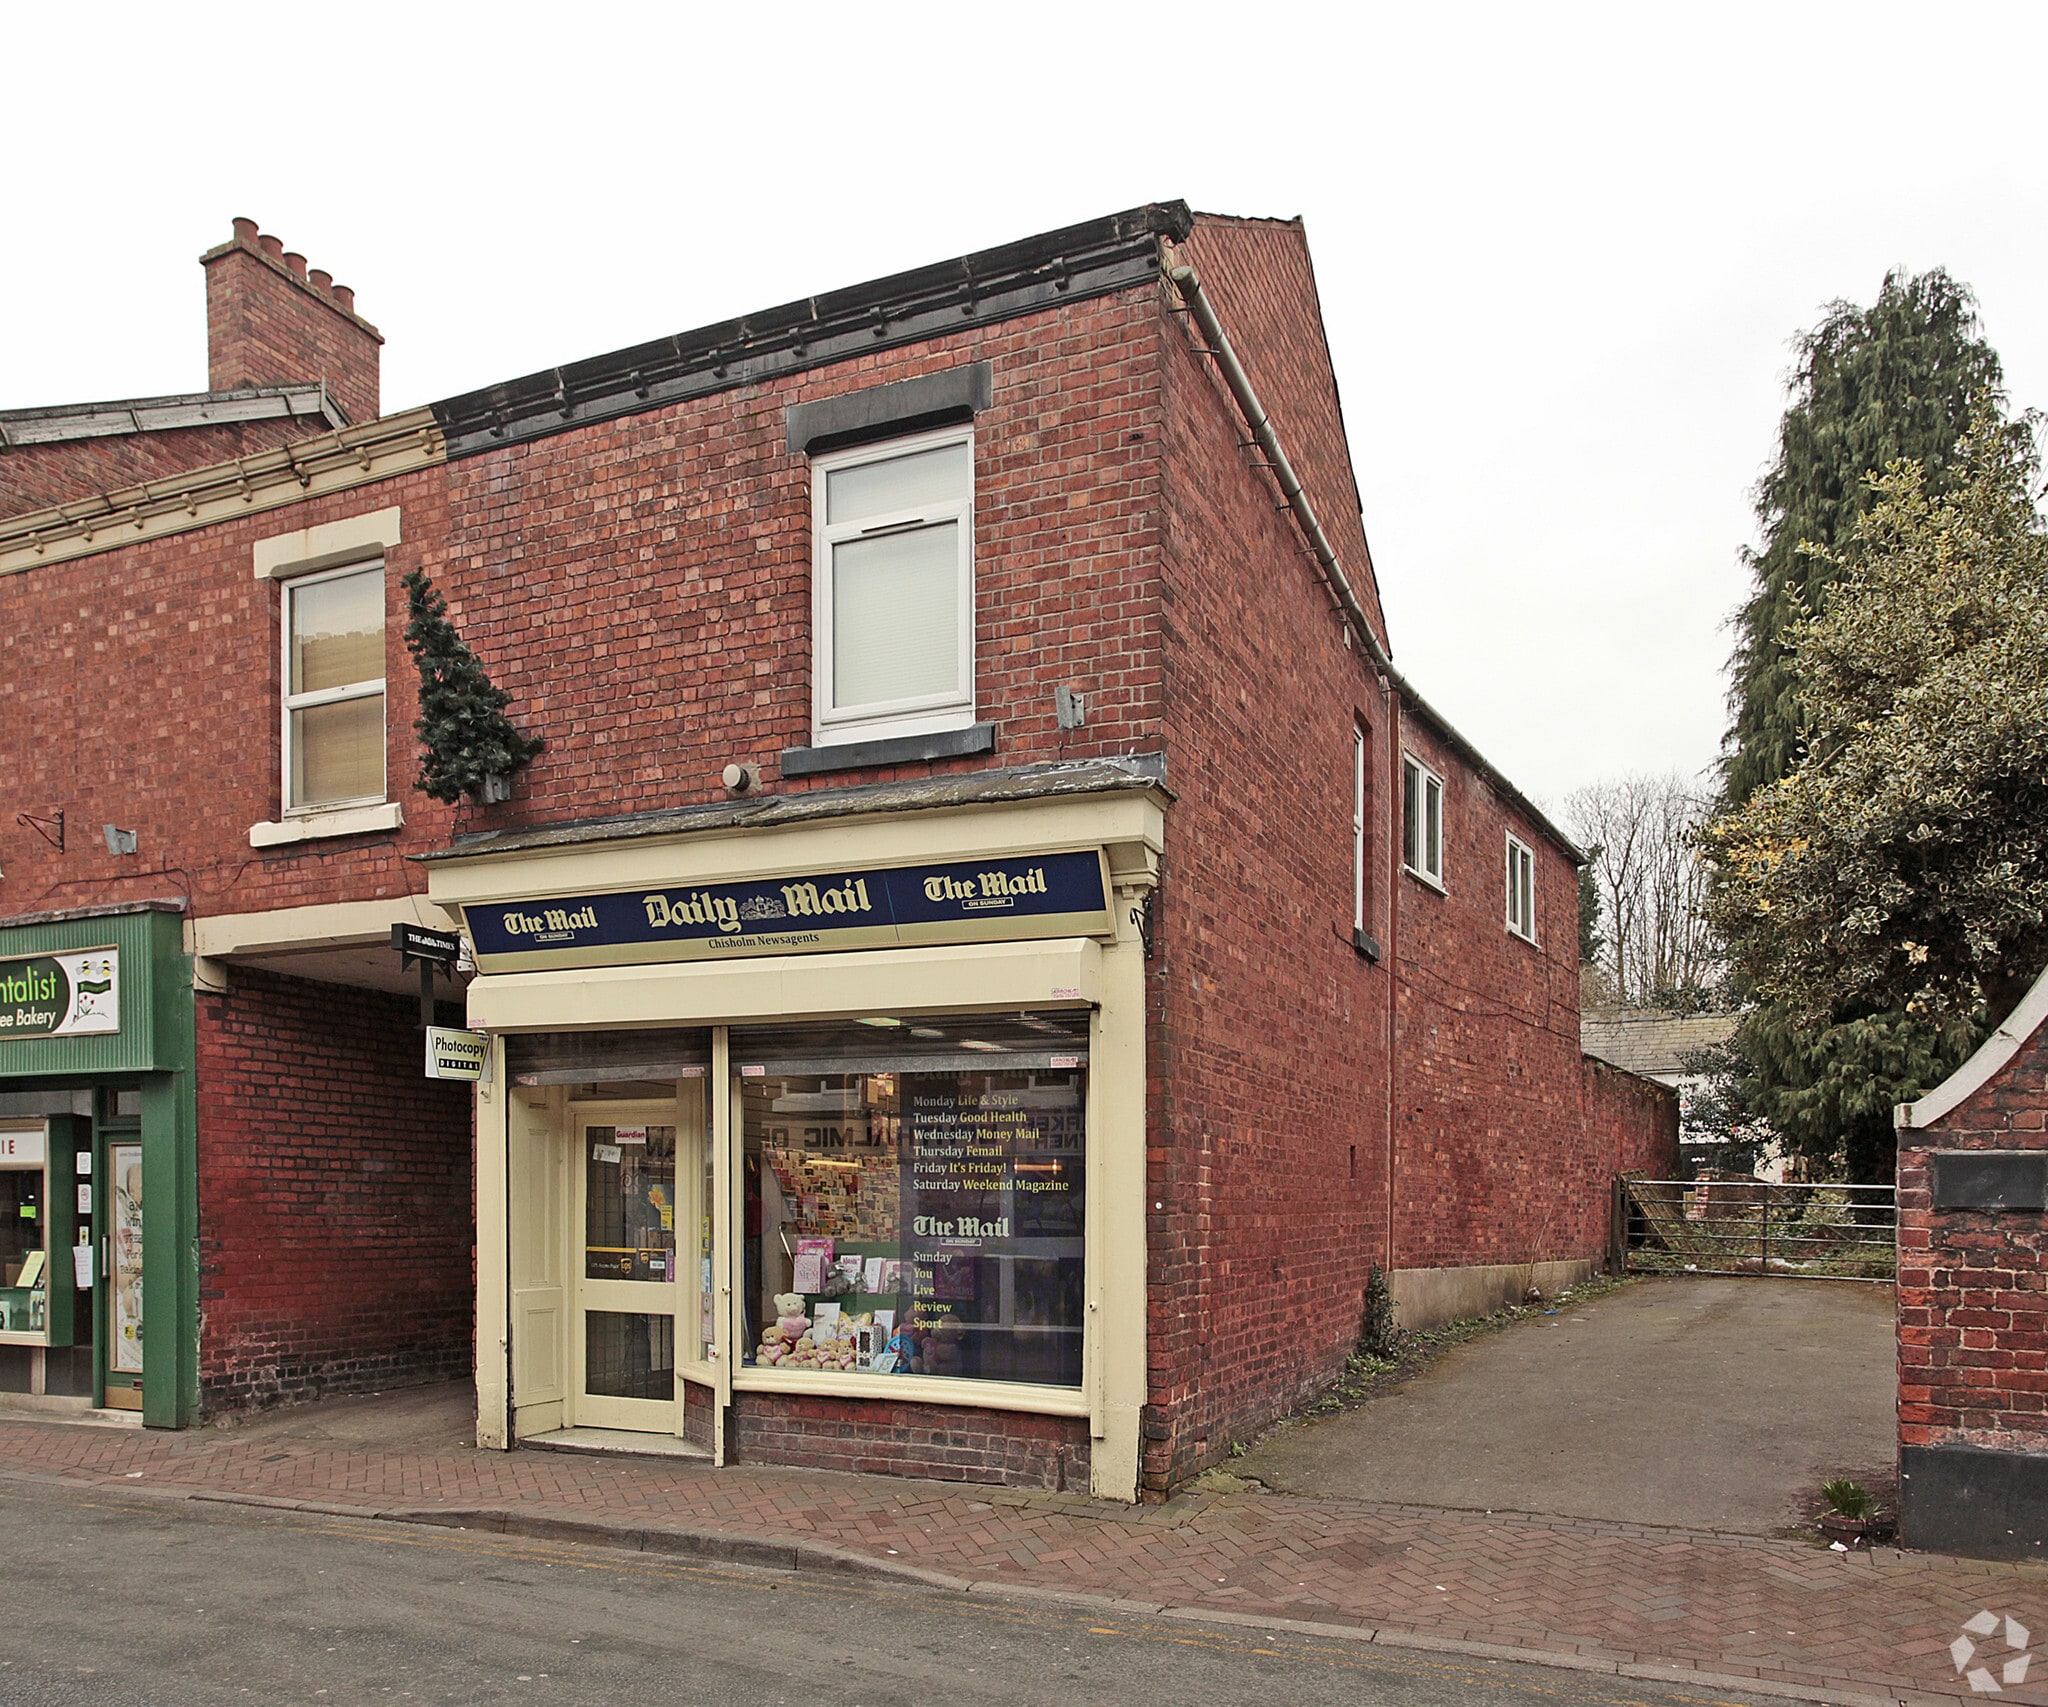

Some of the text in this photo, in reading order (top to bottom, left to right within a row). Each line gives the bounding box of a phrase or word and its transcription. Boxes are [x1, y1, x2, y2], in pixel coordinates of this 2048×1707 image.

[923, 868, 1048, 902] The Mail
[642, 878, 872, 933] Daily Mail
[503, 906, 599, 935] The Mail
[408, 933, 455, 951] THE TIMES
[708, 933, 820, 949] Chisholm Newsagents
[16, 1006, 56, 1029] Bakery
[435, 1036, 485, 1058] Photocopy
[439, 1059, 479, 1070] DIGITAL
[913, 1094, 1019, 1109] Monday Life & Style
[913, 1111, 1027, 1126] Tuesday Good Health
[913, 1127, 1040, 1142] Wednesday Money Mail
[913, 1144, 1003, 1159] Thursday Femail
[913, 1162, 1007, 1176] Friday It's Friday!
[913, 1179, 1069, 1194] Saturday Weekend Magazine
[913, 1215, 1010, 1238] The Mail
[913, 1251, 952, 1266] Sunday
[913, 1267, 933, 1279] You
[913, 1284, 935, 1296] Live
[913, 1301, 952, 1313] Review
[913, 1317, 943, 1331] Sport
